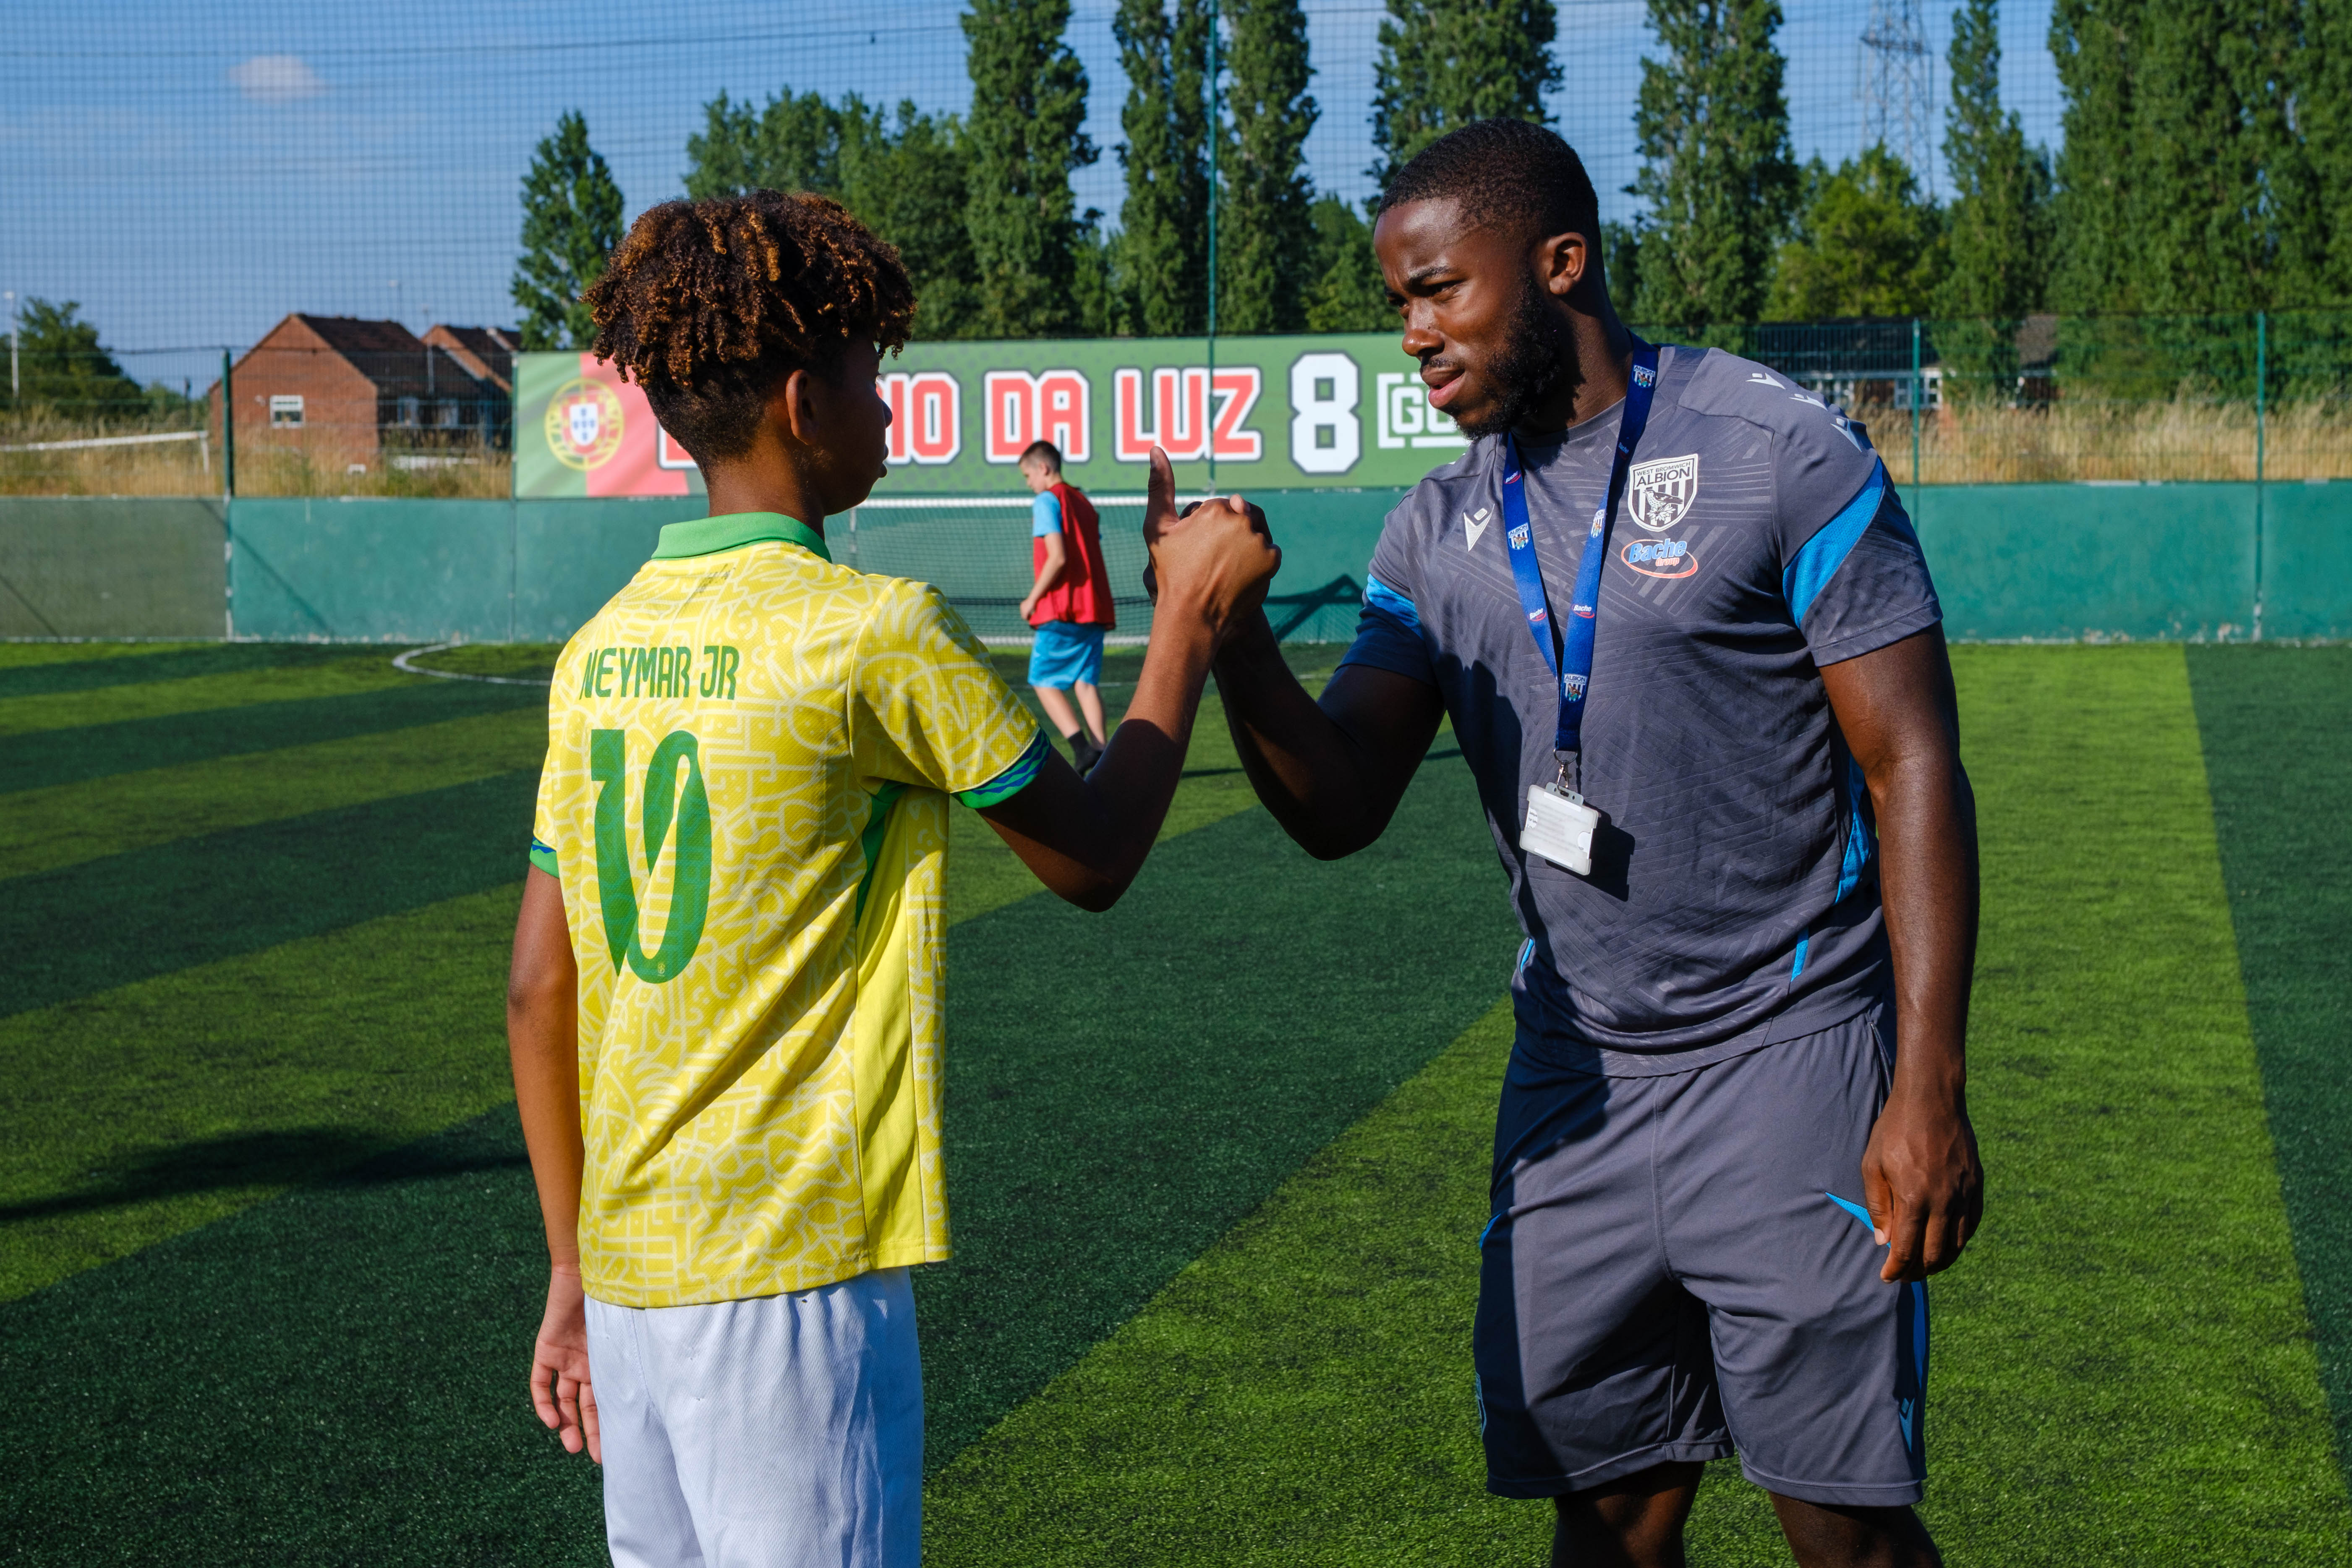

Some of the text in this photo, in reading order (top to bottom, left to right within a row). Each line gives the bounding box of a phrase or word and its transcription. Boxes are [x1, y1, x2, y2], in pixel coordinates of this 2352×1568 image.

[985, 370, 1090, 463] DA
[1114, 367, 1261, 462] LUZ
[1291, 353, 1360, 473] 8
[1636, 467, 1690, 487] ALBION
[1656, 462, 1691, 473] BROMWICH
[1628, 538, 1687, 563] Bache
[1655, 557, 1680, 567] Group
[579, 645, 740, 700] NEYMAR JR
[591, 729, 712, 984] 10
